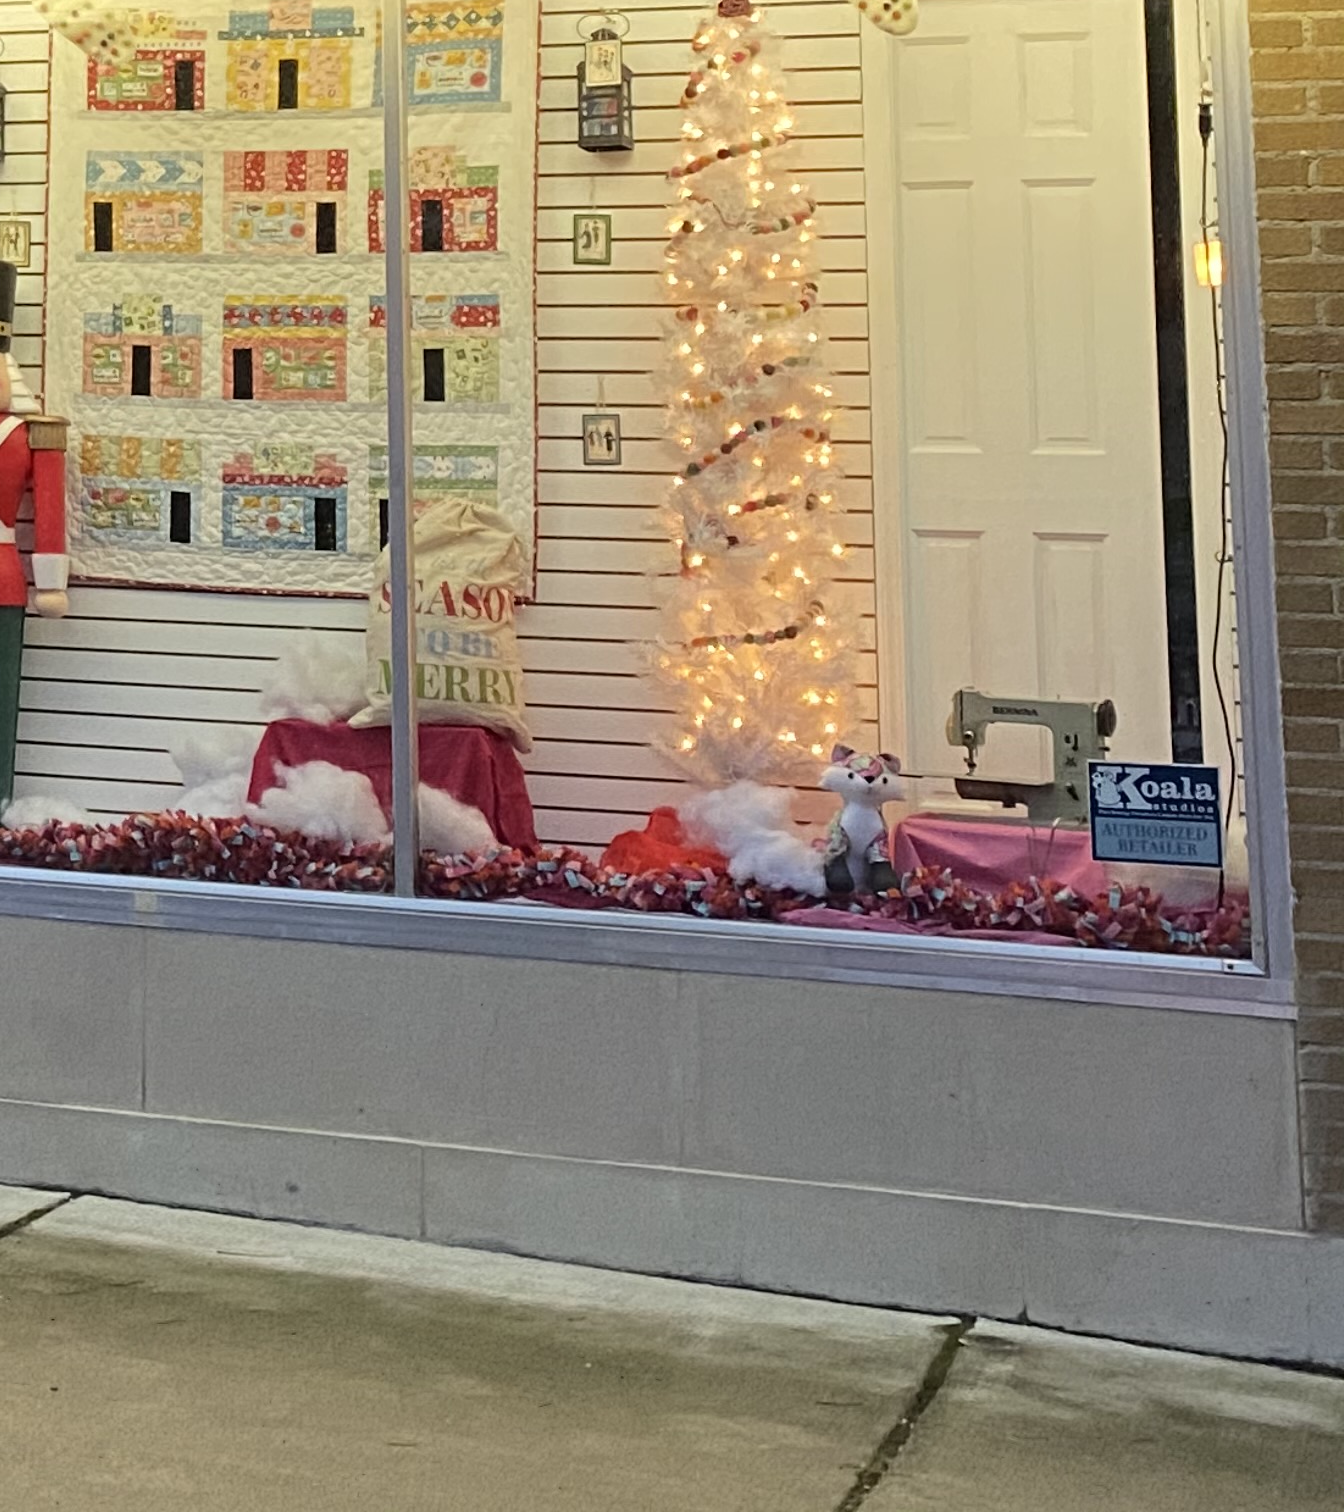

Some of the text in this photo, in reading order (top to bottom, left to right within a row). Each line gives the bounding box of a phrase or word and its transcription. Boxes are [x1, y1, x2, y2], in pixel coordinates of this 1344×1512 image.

[1096, 765, 1216, 811] Koala
[1152, 803, 1214, 814] studios
[1101, 823, 1208, 842] AUTHORIZED
[1118, 839, 1198, 857] RETAILER
